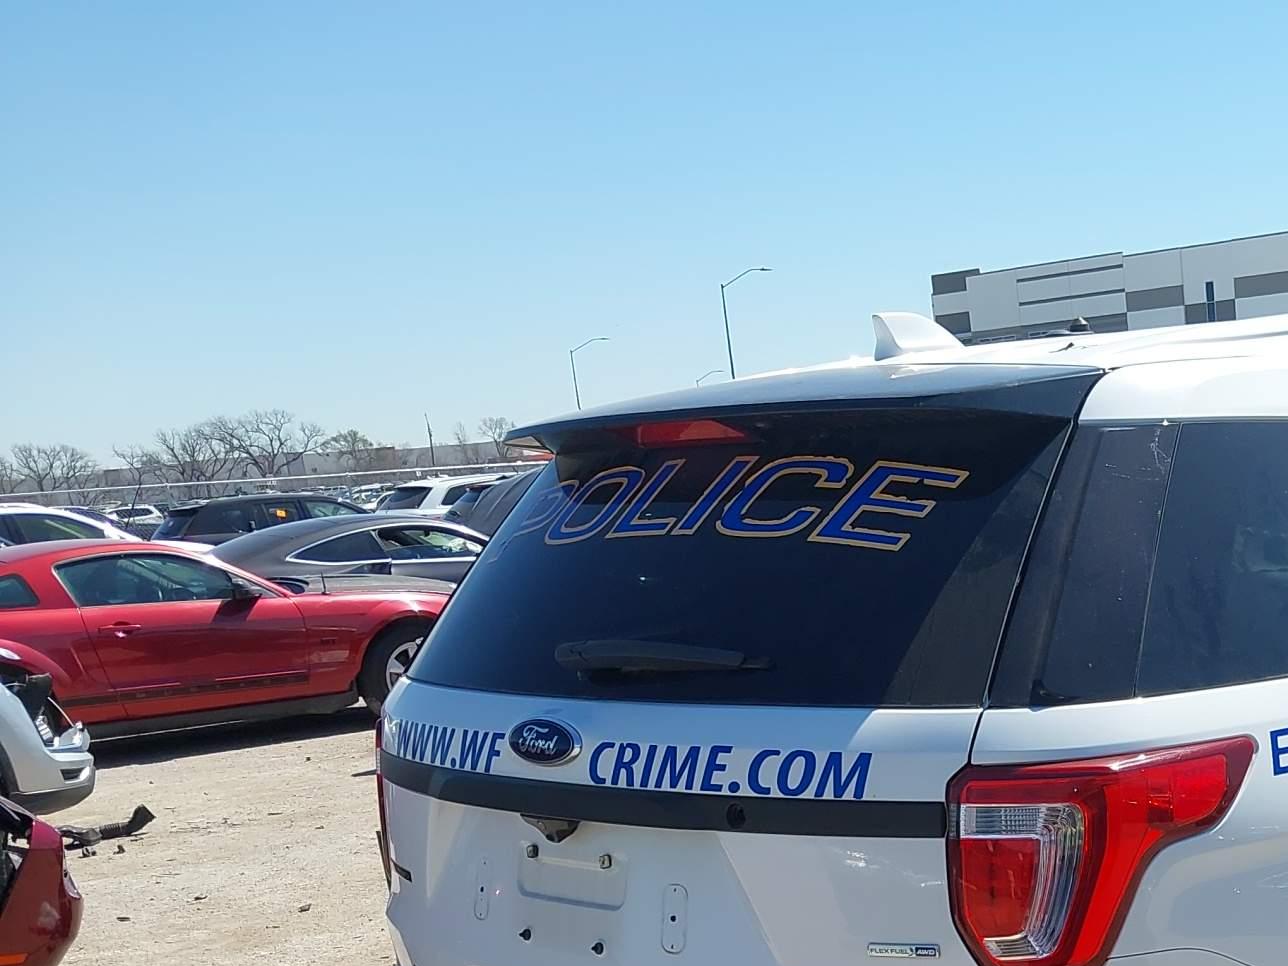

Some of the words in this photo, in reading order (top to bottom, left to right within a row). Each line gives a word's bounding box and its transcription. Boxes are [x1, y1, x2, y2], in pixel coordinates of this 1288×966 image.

[488, 456, 970, 564] POLICE
[396, 718, 506, 774] WWW.WF
[518, 724, 559, 756] Ford
[588, 740, 873, 800] CRIME.COM
